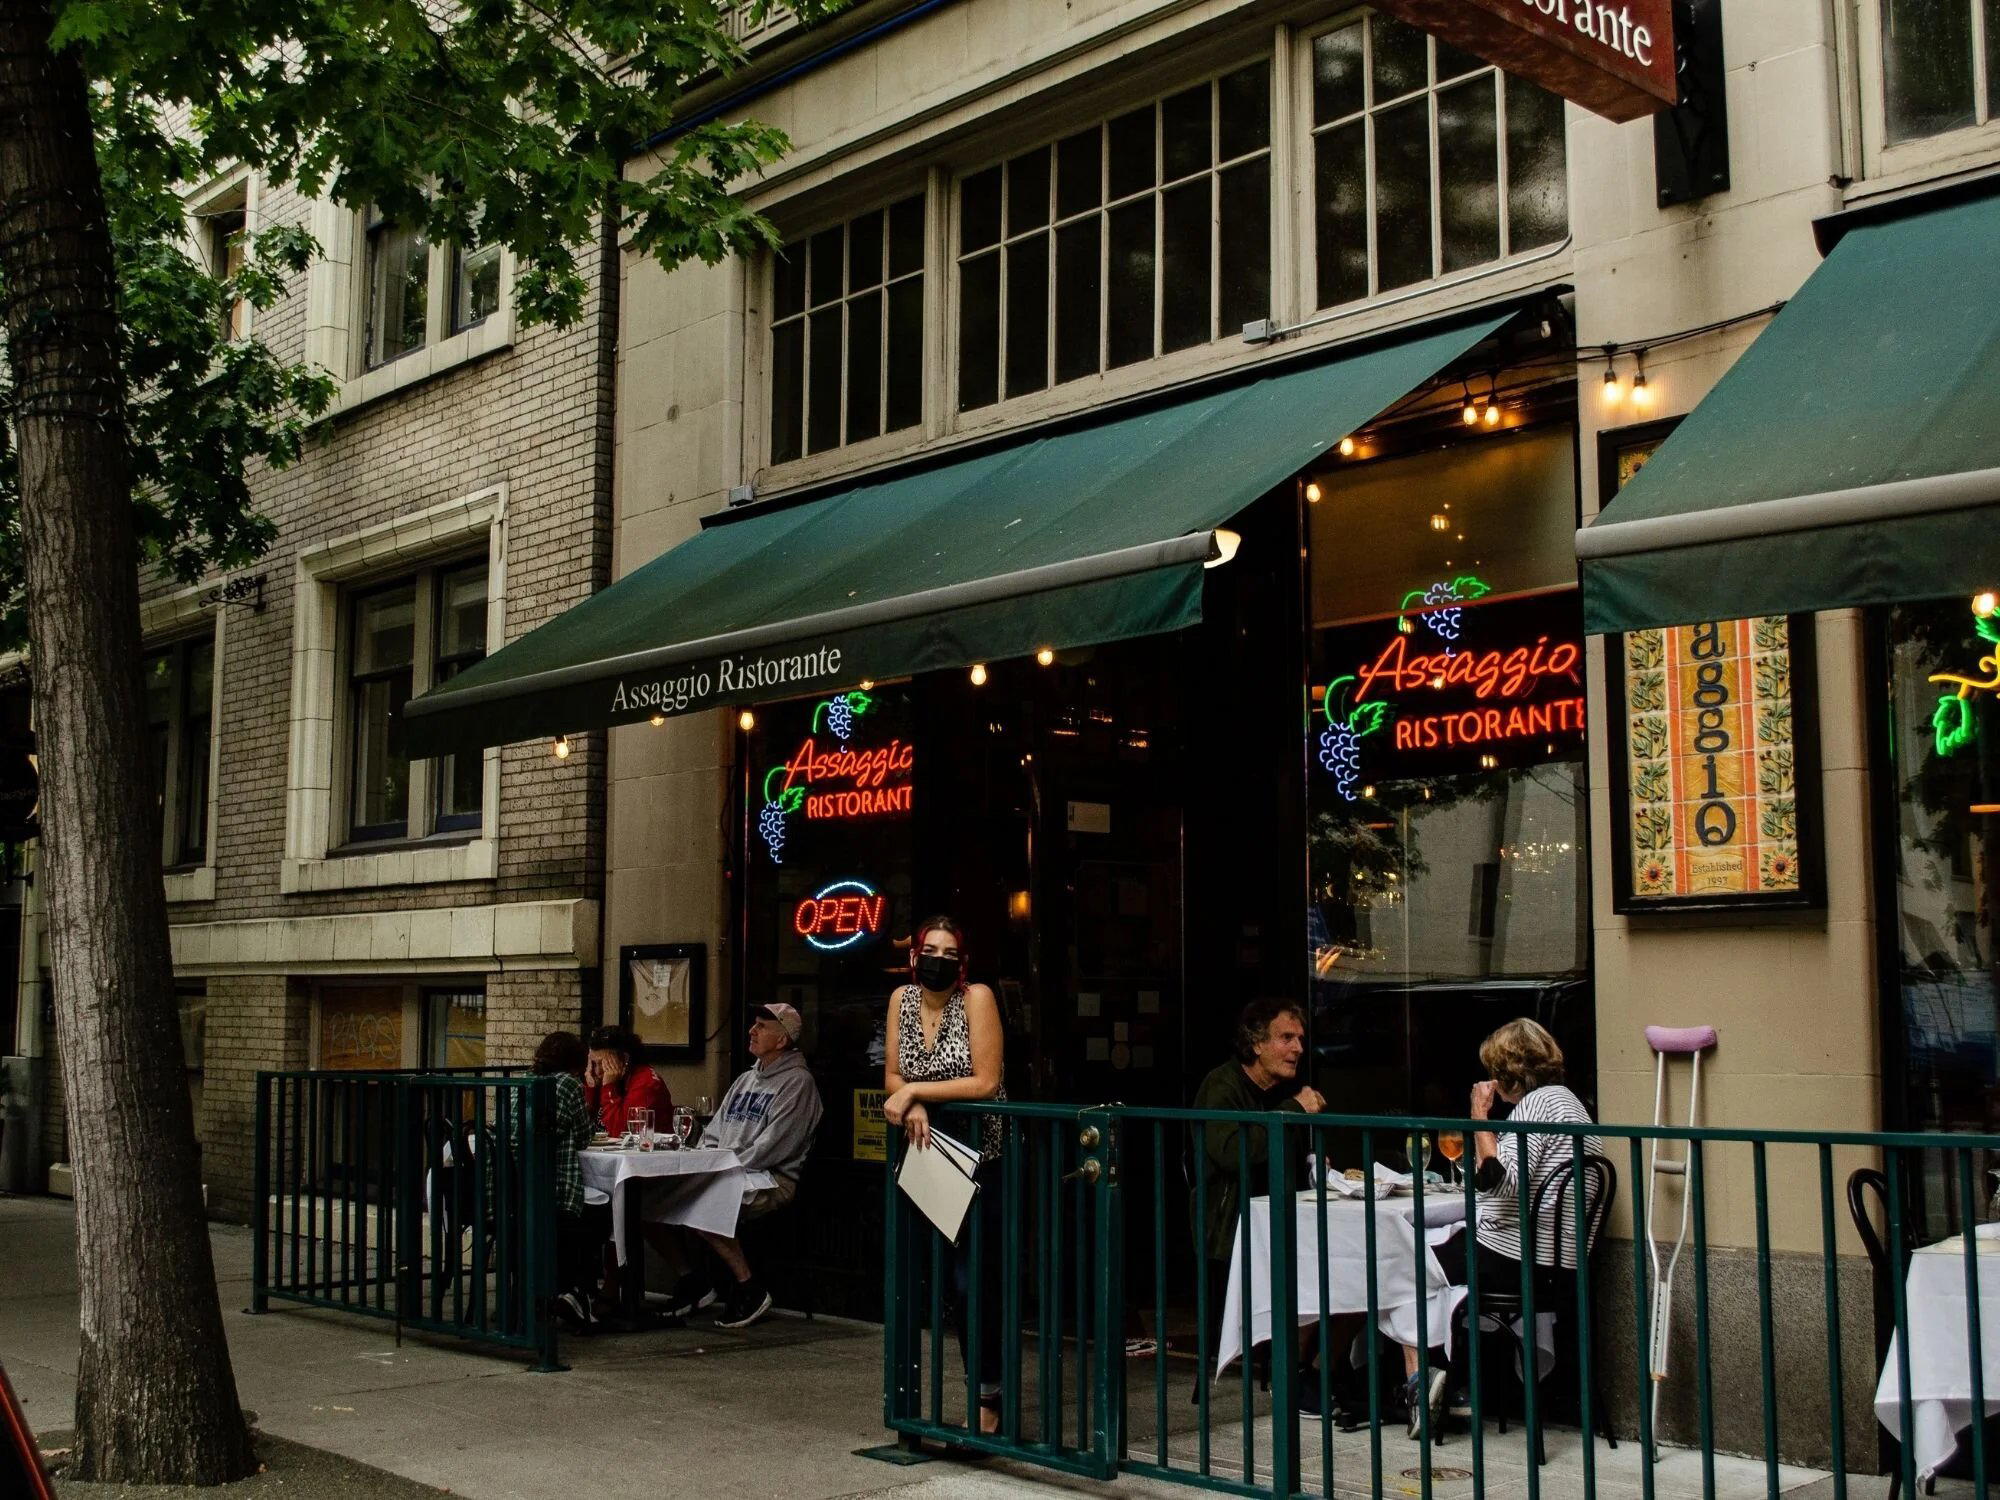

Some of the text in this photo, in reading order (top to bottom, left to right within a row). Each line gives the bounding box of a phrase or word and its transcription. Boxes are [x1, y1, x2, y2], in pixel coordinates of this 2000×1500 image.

[611, 644, 842, 713] Assaggio Ristorante
[1355, 636, 1578, 703] Assaggio
[784, 738, 913, 792] Assaggio
[1692, 861, 1743, 874] Established
[1707, 876, 1728, 886] 1993
[796, 897, 883, 934] OPEN
